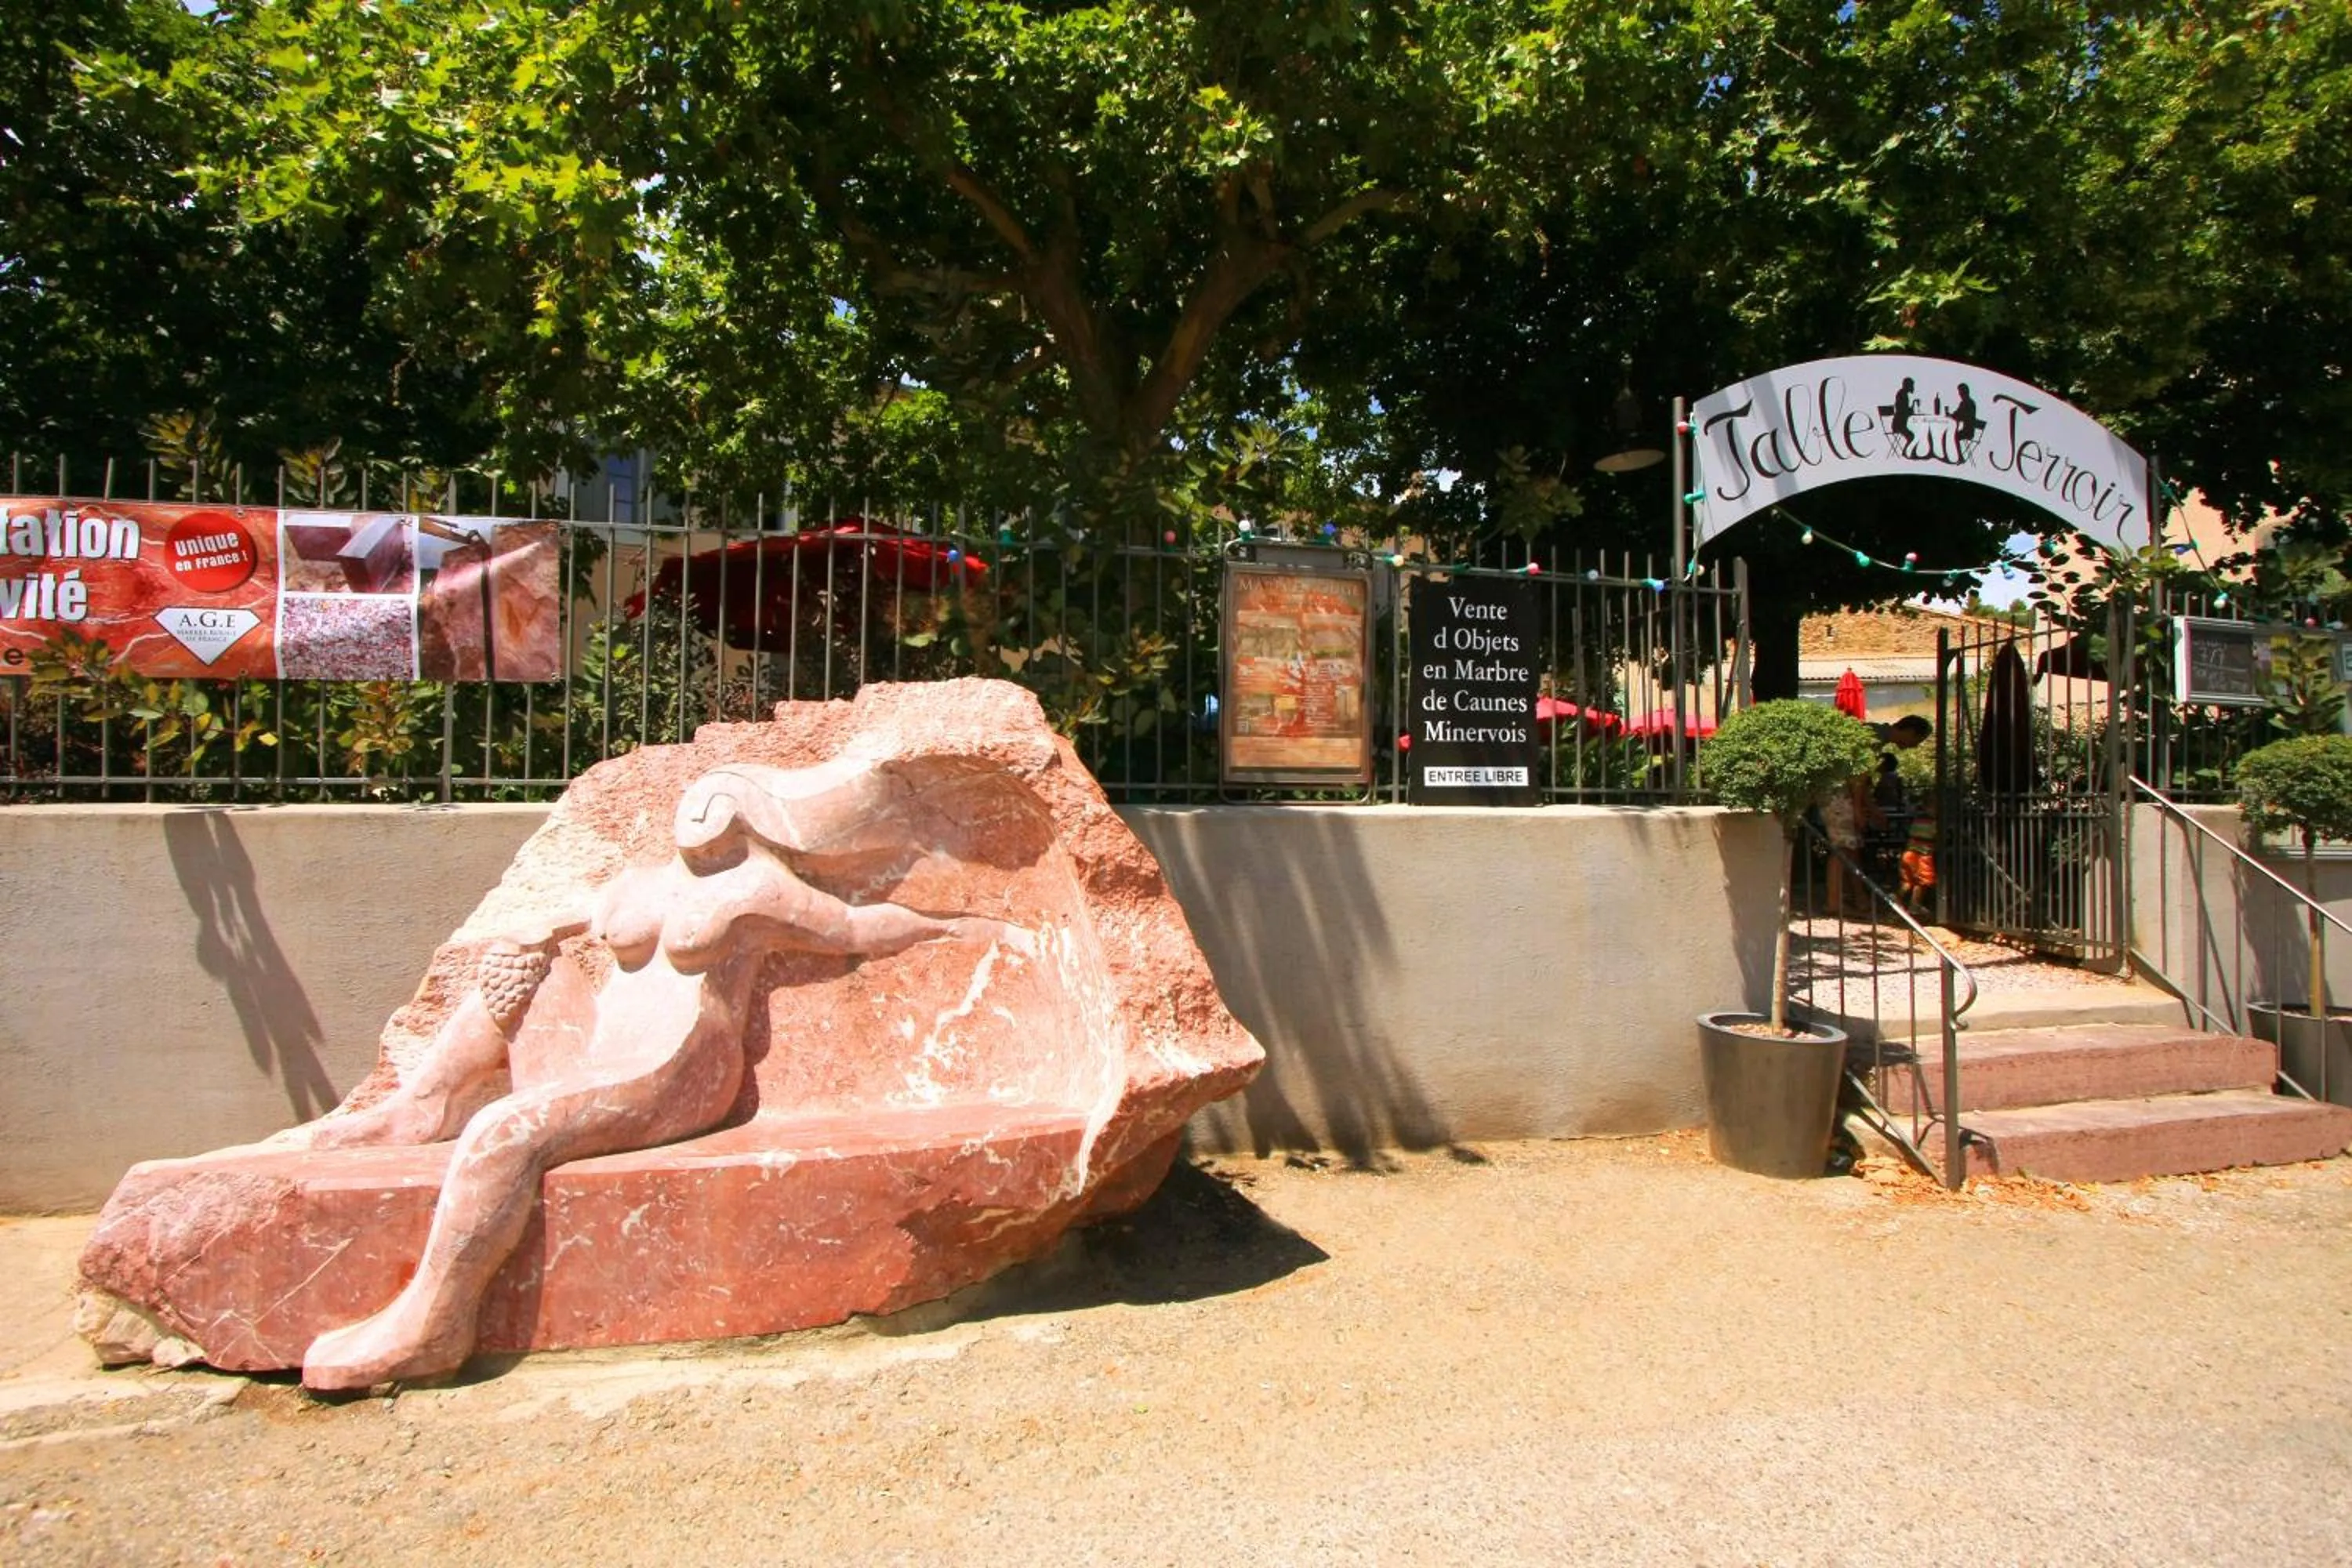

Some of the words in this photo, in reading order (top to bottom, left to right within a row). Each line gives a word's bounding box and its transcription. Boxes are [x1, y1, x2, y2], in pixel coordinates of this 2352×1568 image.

[1704, 376, 1875, 501] Table
[1989, 394, 2134, 543] Terroir
[1449, 597, 1508, 620] Vente
[1434, 627, 1446, 648] d
[1454, 628, 1519, 655] Objets
[1423, 663, 1446, 679] en
[1454, 659, 1529, 681] Marbre
[1422, 689, 1447, 710] de
[1454, 690, 1528, 713] Caunes
[1424, 720, 1526, 742] Minervois
[1428, 771, 1480, 782] ENTREE
[1484, 771, 1523, 782] LIBRE
